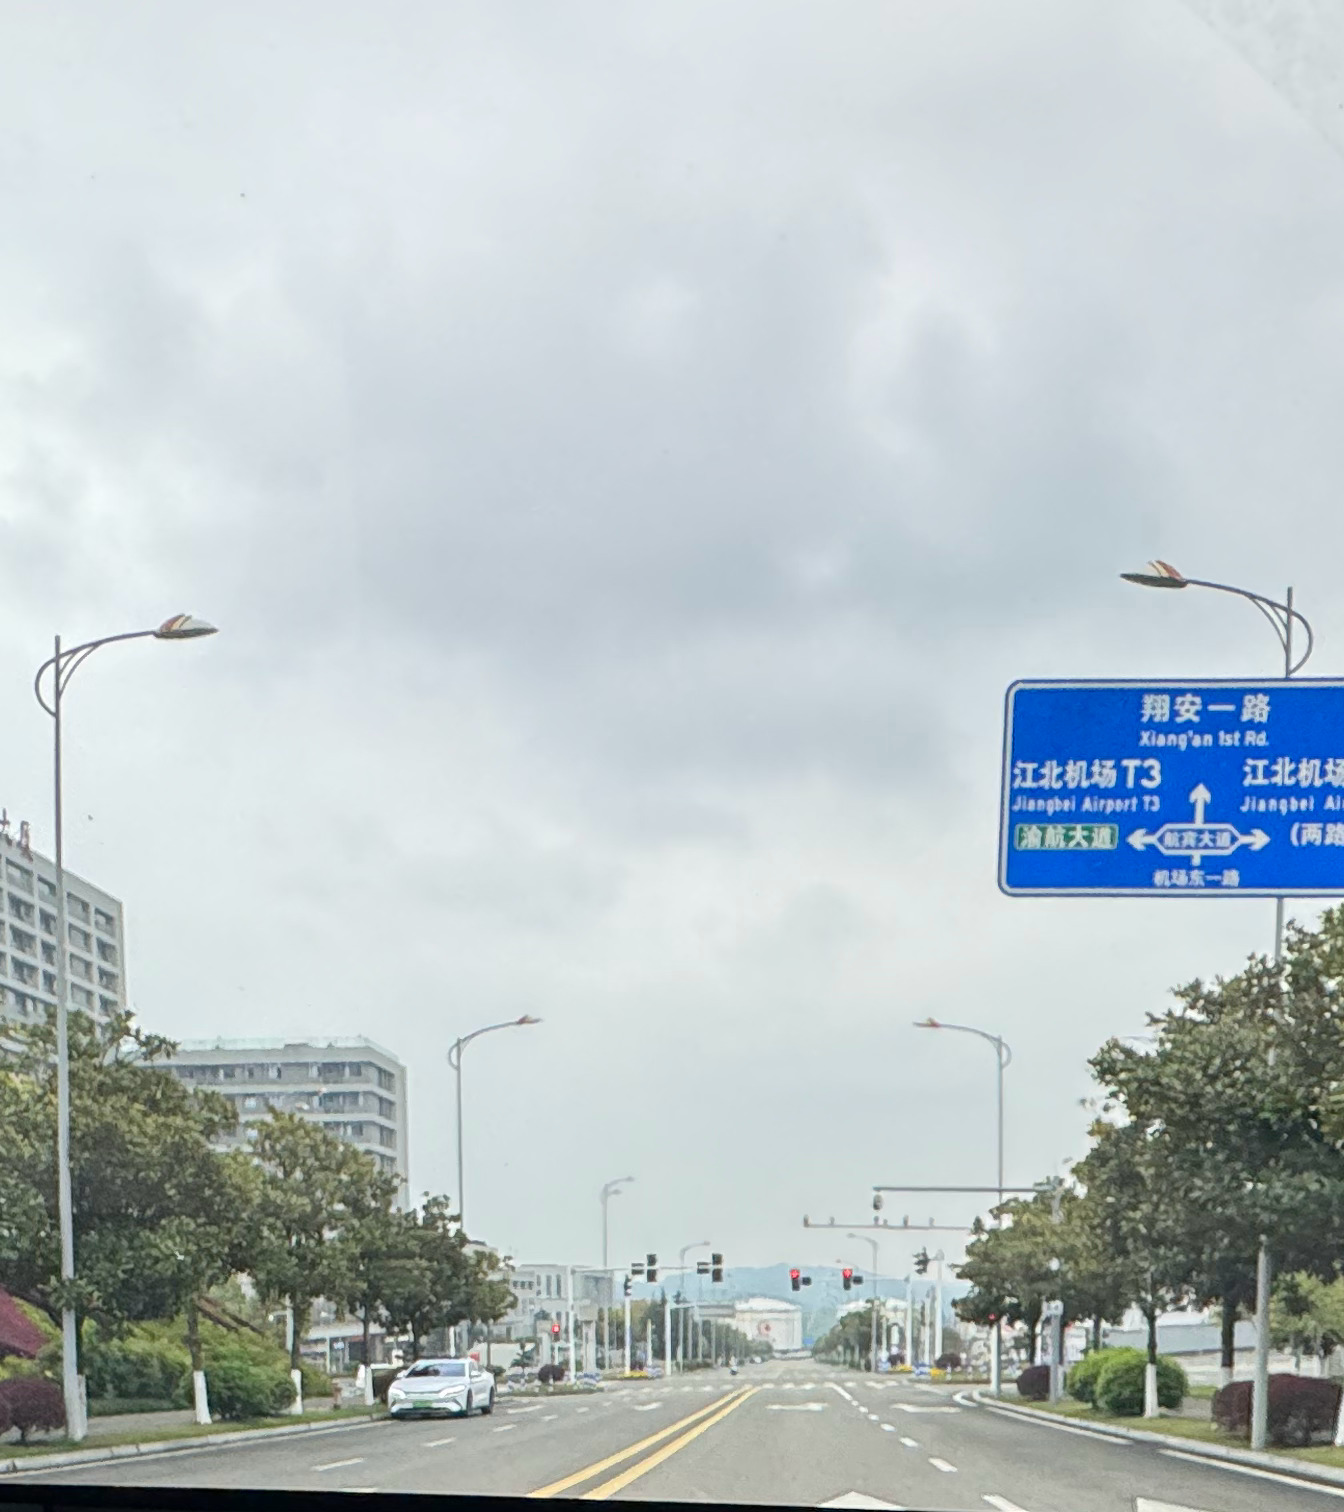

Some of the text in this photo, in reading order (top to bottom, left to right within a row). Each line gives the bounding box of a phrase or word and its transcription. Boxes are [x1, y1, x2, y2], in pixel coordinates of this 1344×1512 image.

[1140, 693, 1271, 723] 翔安一路
[1139, 731, 1269, 750] Xiang'an 1st Rd.
[1012, 759, 1162, 789] 江北机场T3
[1011, 796, 1160, 815] Jiangbei Airport T3
[1240, 795, 1315, 815] Jiangbei
[1154, 869, 1240, 887] 机场东一路
